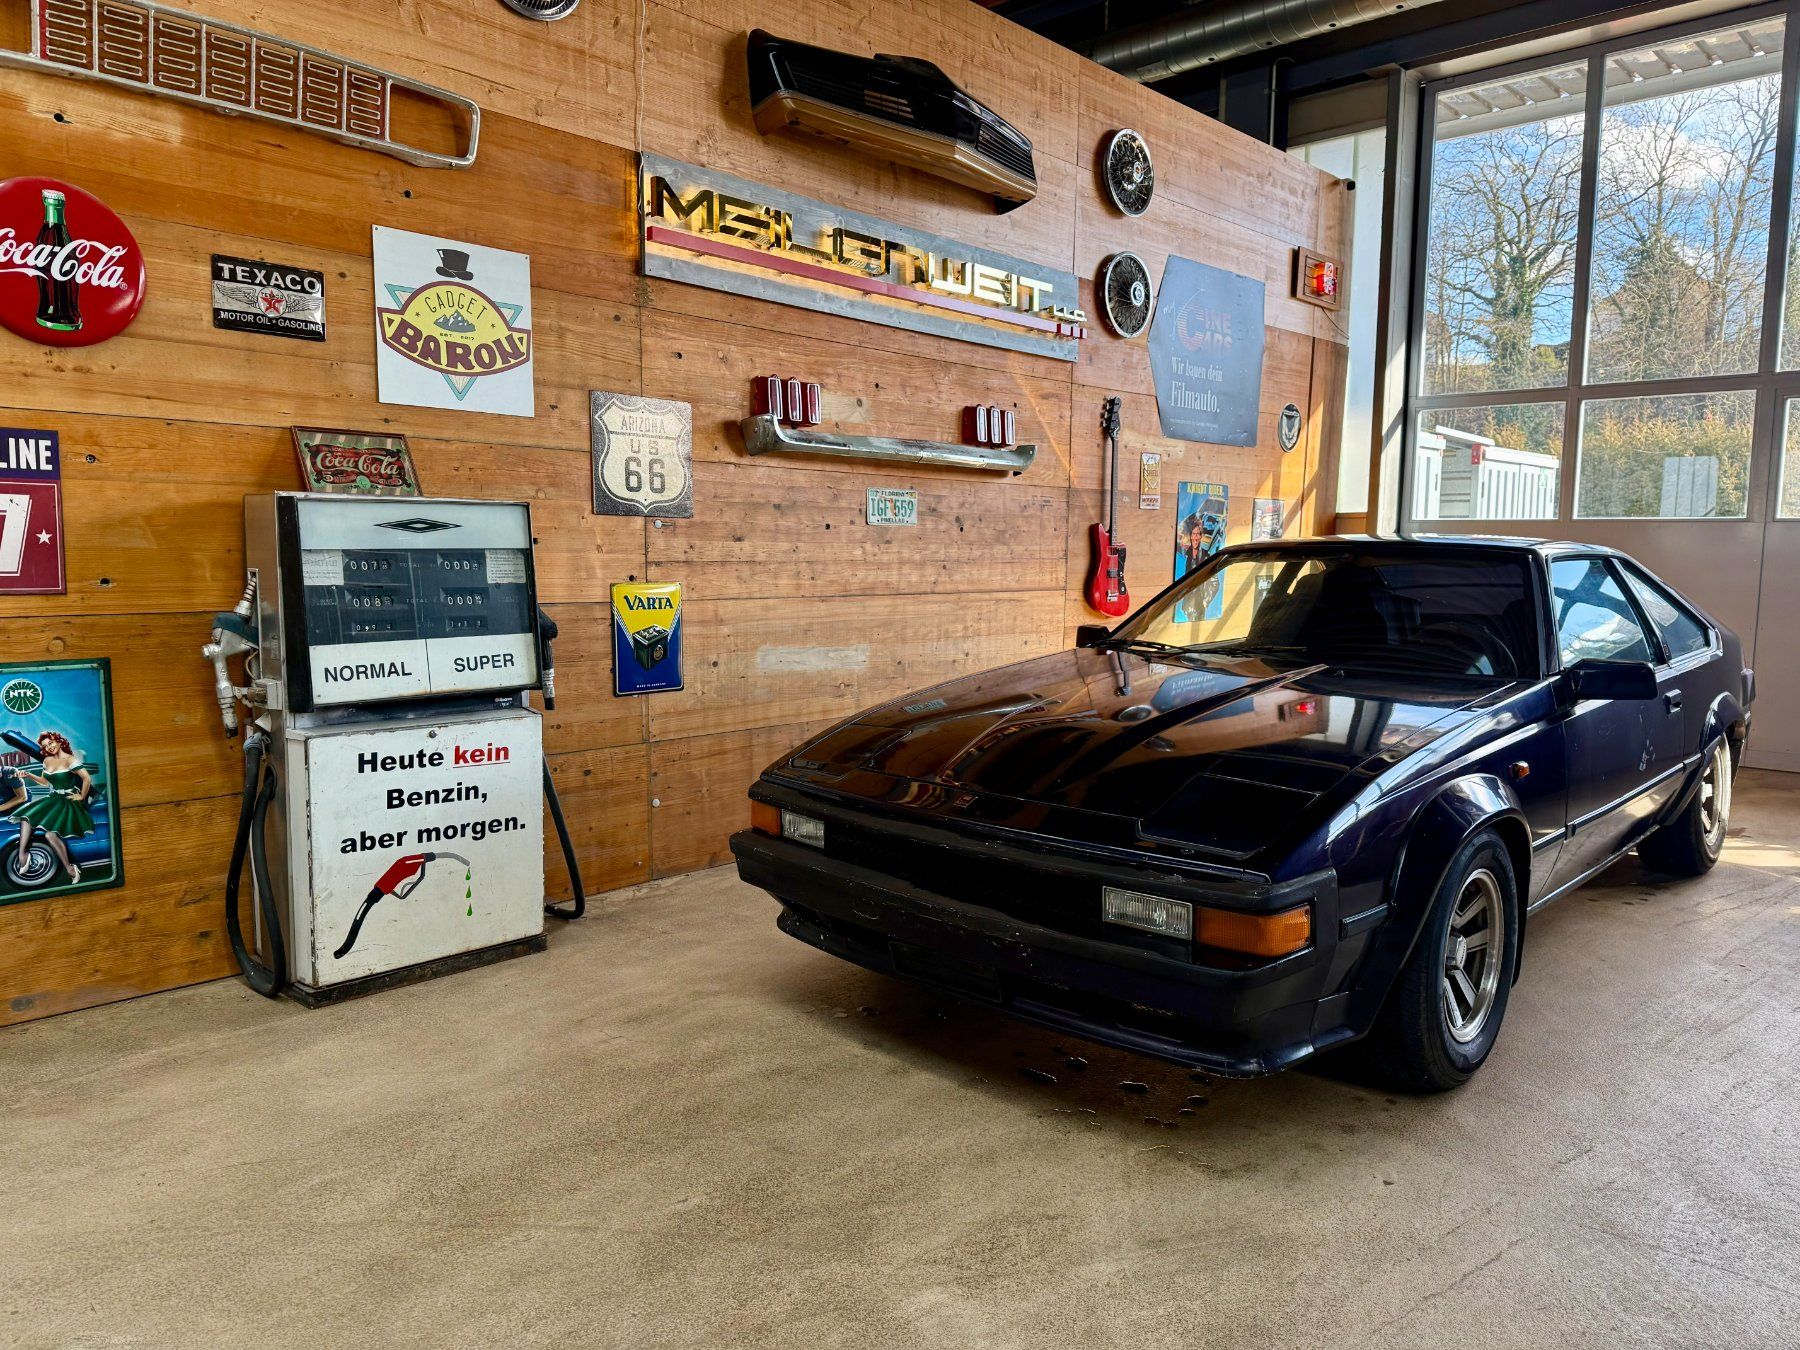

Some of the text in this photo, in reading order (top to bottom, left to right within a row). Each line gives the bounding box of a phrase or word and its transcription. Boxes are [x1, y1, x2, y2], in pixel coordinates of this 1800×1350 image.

[217, 262, 321, 294] TEXACO
[219, 310, 255, 323] MOTOR
[256, 315, 271, 325] OIL
[424, 290, 487, 320] GADGET
[388, 317, 526, 371] BARON
[1170, 381, 1220, 413] Filmauto.
[621, 414, 666, 434] ARIZONA
[624, 456, 666, 494] 66
[894, 499, 914, 518] 559
[624, 595, 674, 610] VARTA
[324, 653, 515, 683] NORMAL SUPER
[357, 743, 510, 774] Heute kein
[386, 782, 488, 809] Benzin,
[340, 816, 526, 854] aber morgen.
